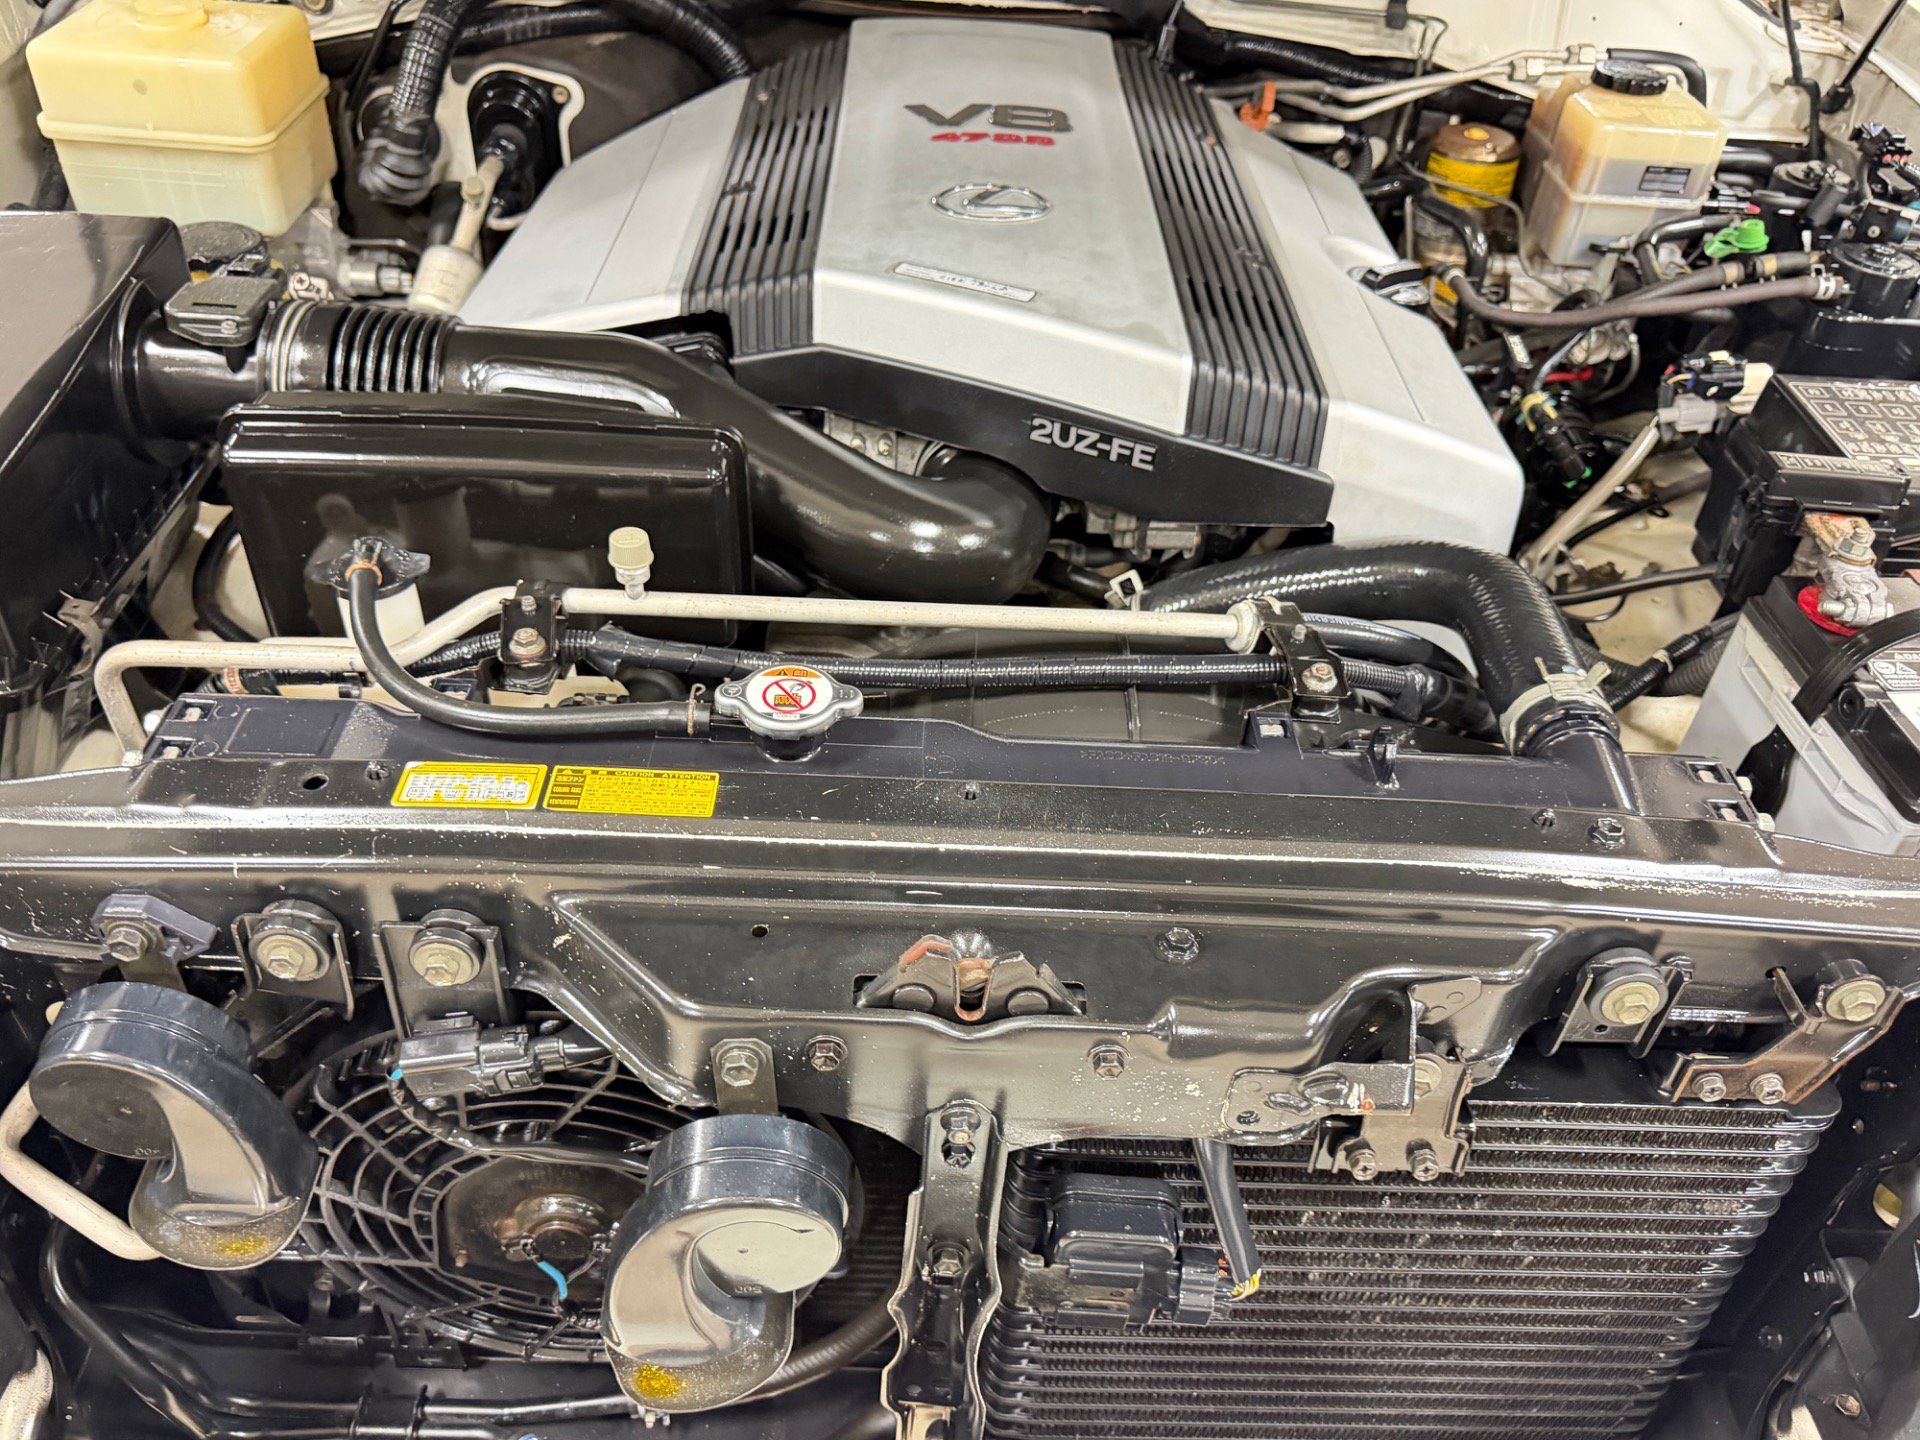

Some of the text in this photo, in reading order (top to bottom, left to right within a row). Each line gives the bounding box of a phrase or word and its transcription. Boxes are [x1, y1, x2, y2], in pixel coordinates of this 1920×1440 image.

[903, 103, 1073, 132] V8
[1029, 417, 1157, 471] 2UZ-FE
[614, 770, 655, 778] CAUTION
[661, 772, 711, 780] ATTENTION
